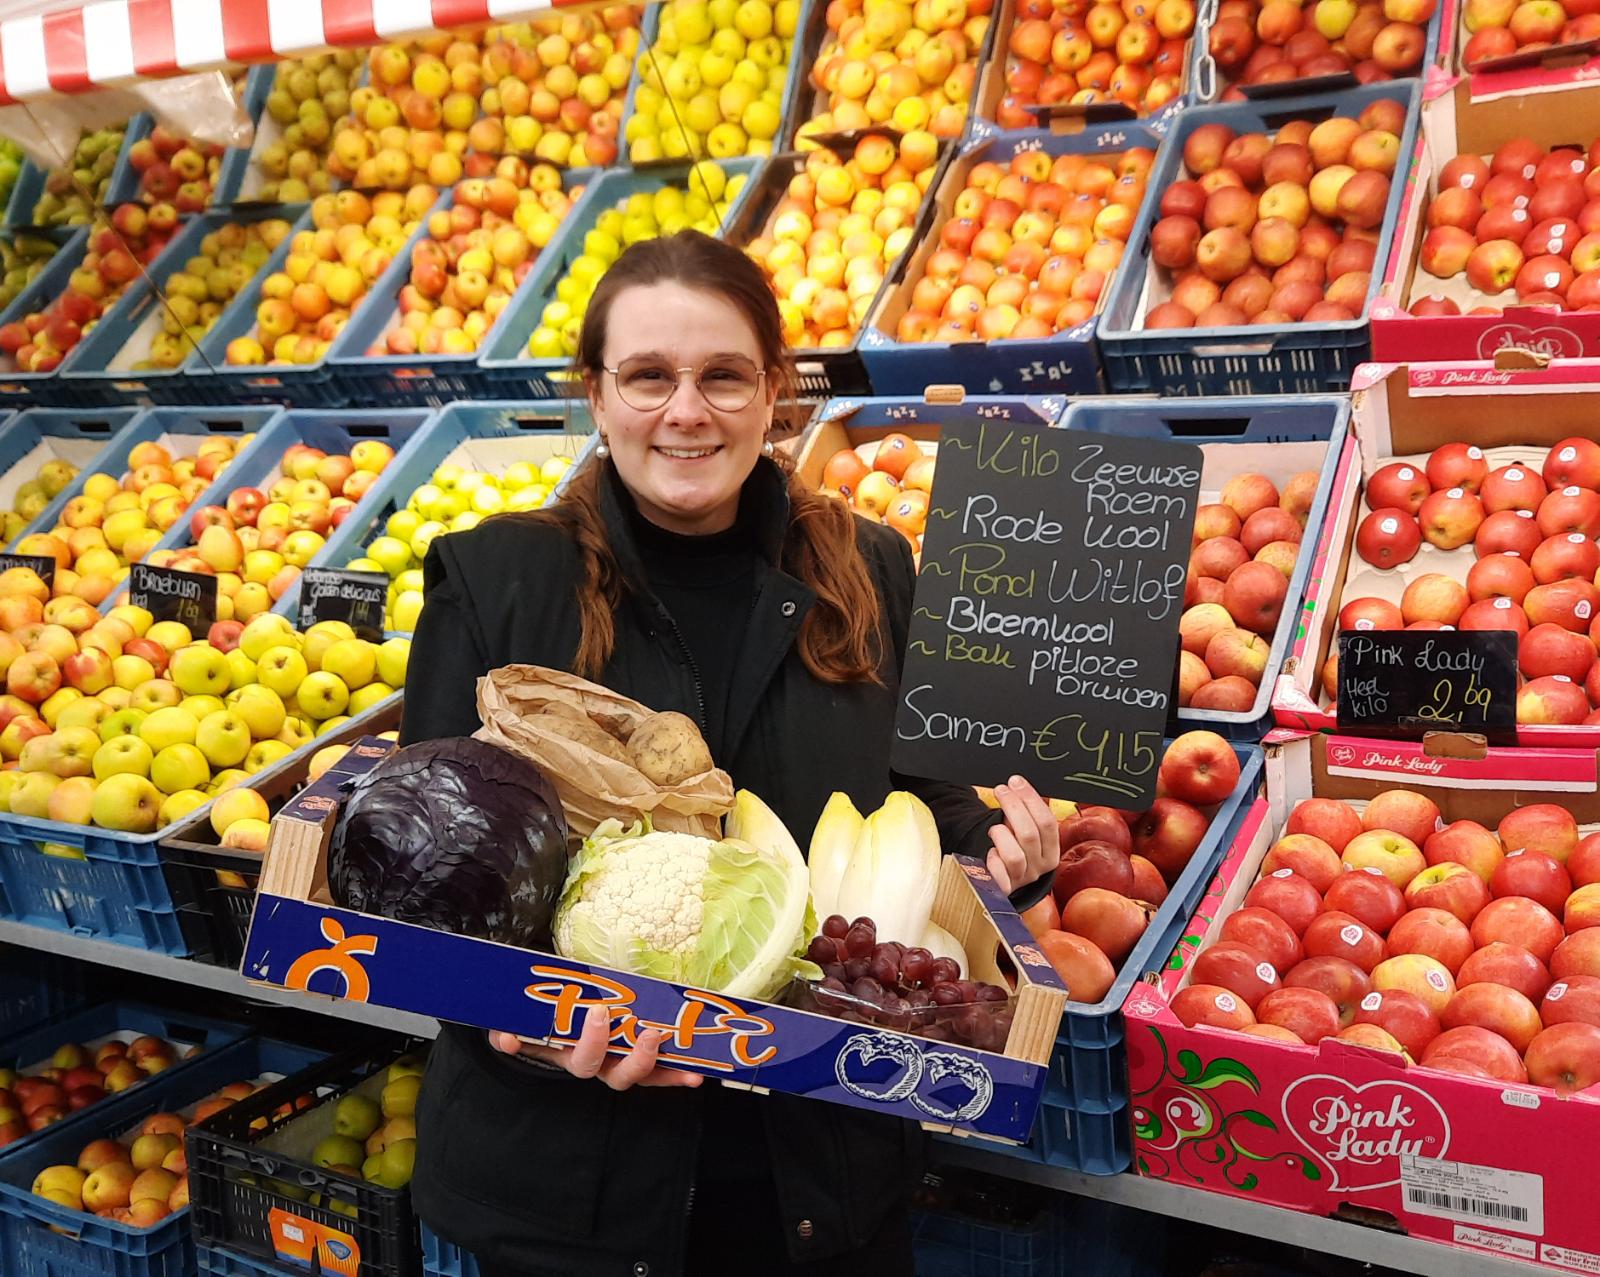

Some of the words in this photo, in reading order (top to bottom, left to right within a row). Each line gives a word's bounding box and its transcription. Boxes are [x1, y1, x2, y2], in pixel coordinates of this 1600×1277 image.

[976, 424, 1059, 477] Kilo
[1071, 445, 1199, 488] Zeeuwse
[962, 494, 1064, 544] Rode
[1086, 481, 1187, 519] Roem
[949, 543, 1035, 598] Pond
[1048, 558, 1186, 621] Witlof
[946, 596, 1114, 645] Bloemkool
[1029, 646, 1139, 685] pitloze
[1347, 636, 1404, 666] Pink
[1414, 640, 1485, 686] Lady
[896, 685, 1027, 752] Samen
[1362, 752, 1404, 766] Pink
[1403, 757, 1444, 774] Lady
[1309, 1094, 1416, 1135] Pink
[1326, 1127, 1424, 1165] Lady
